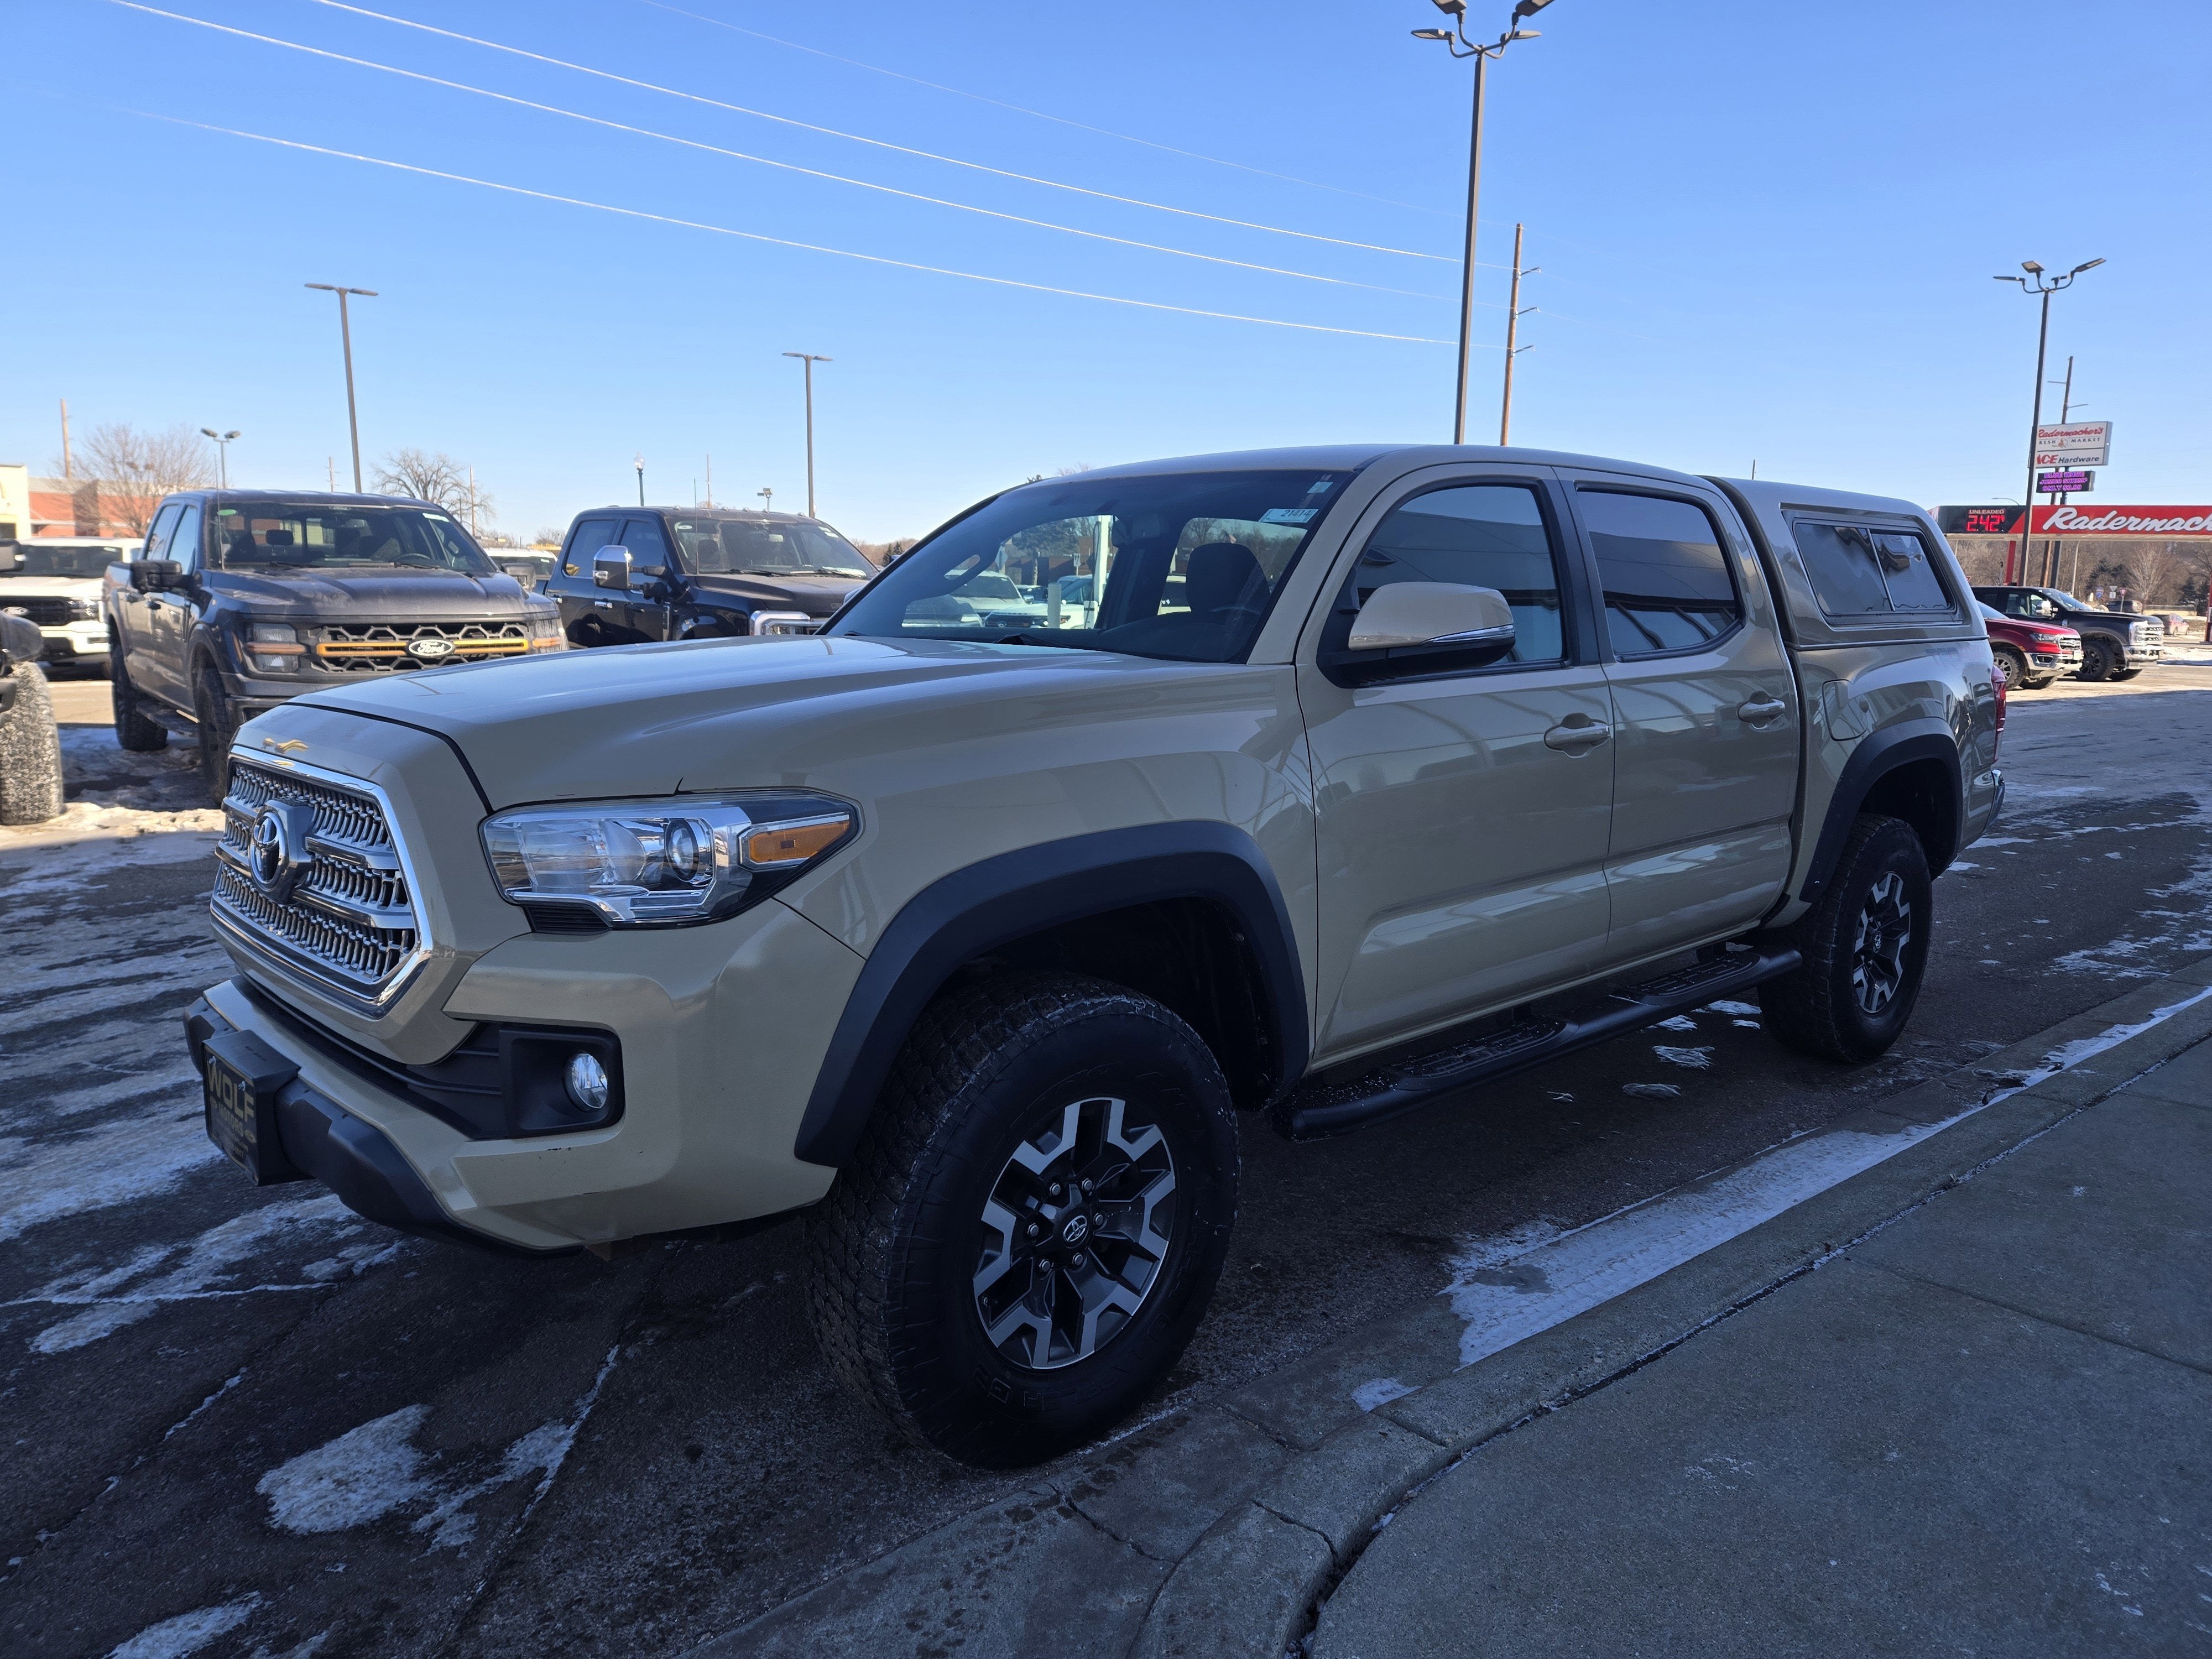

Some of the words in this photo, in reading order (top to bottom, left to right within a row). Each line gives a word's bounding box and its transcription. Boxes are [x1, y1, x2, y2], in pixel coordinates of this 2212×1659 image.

[417, 641, 445, 653] Ford
[207, 1060, 254, 1123] WOLF
[218, 1102, 244, 1138] MOTORS
